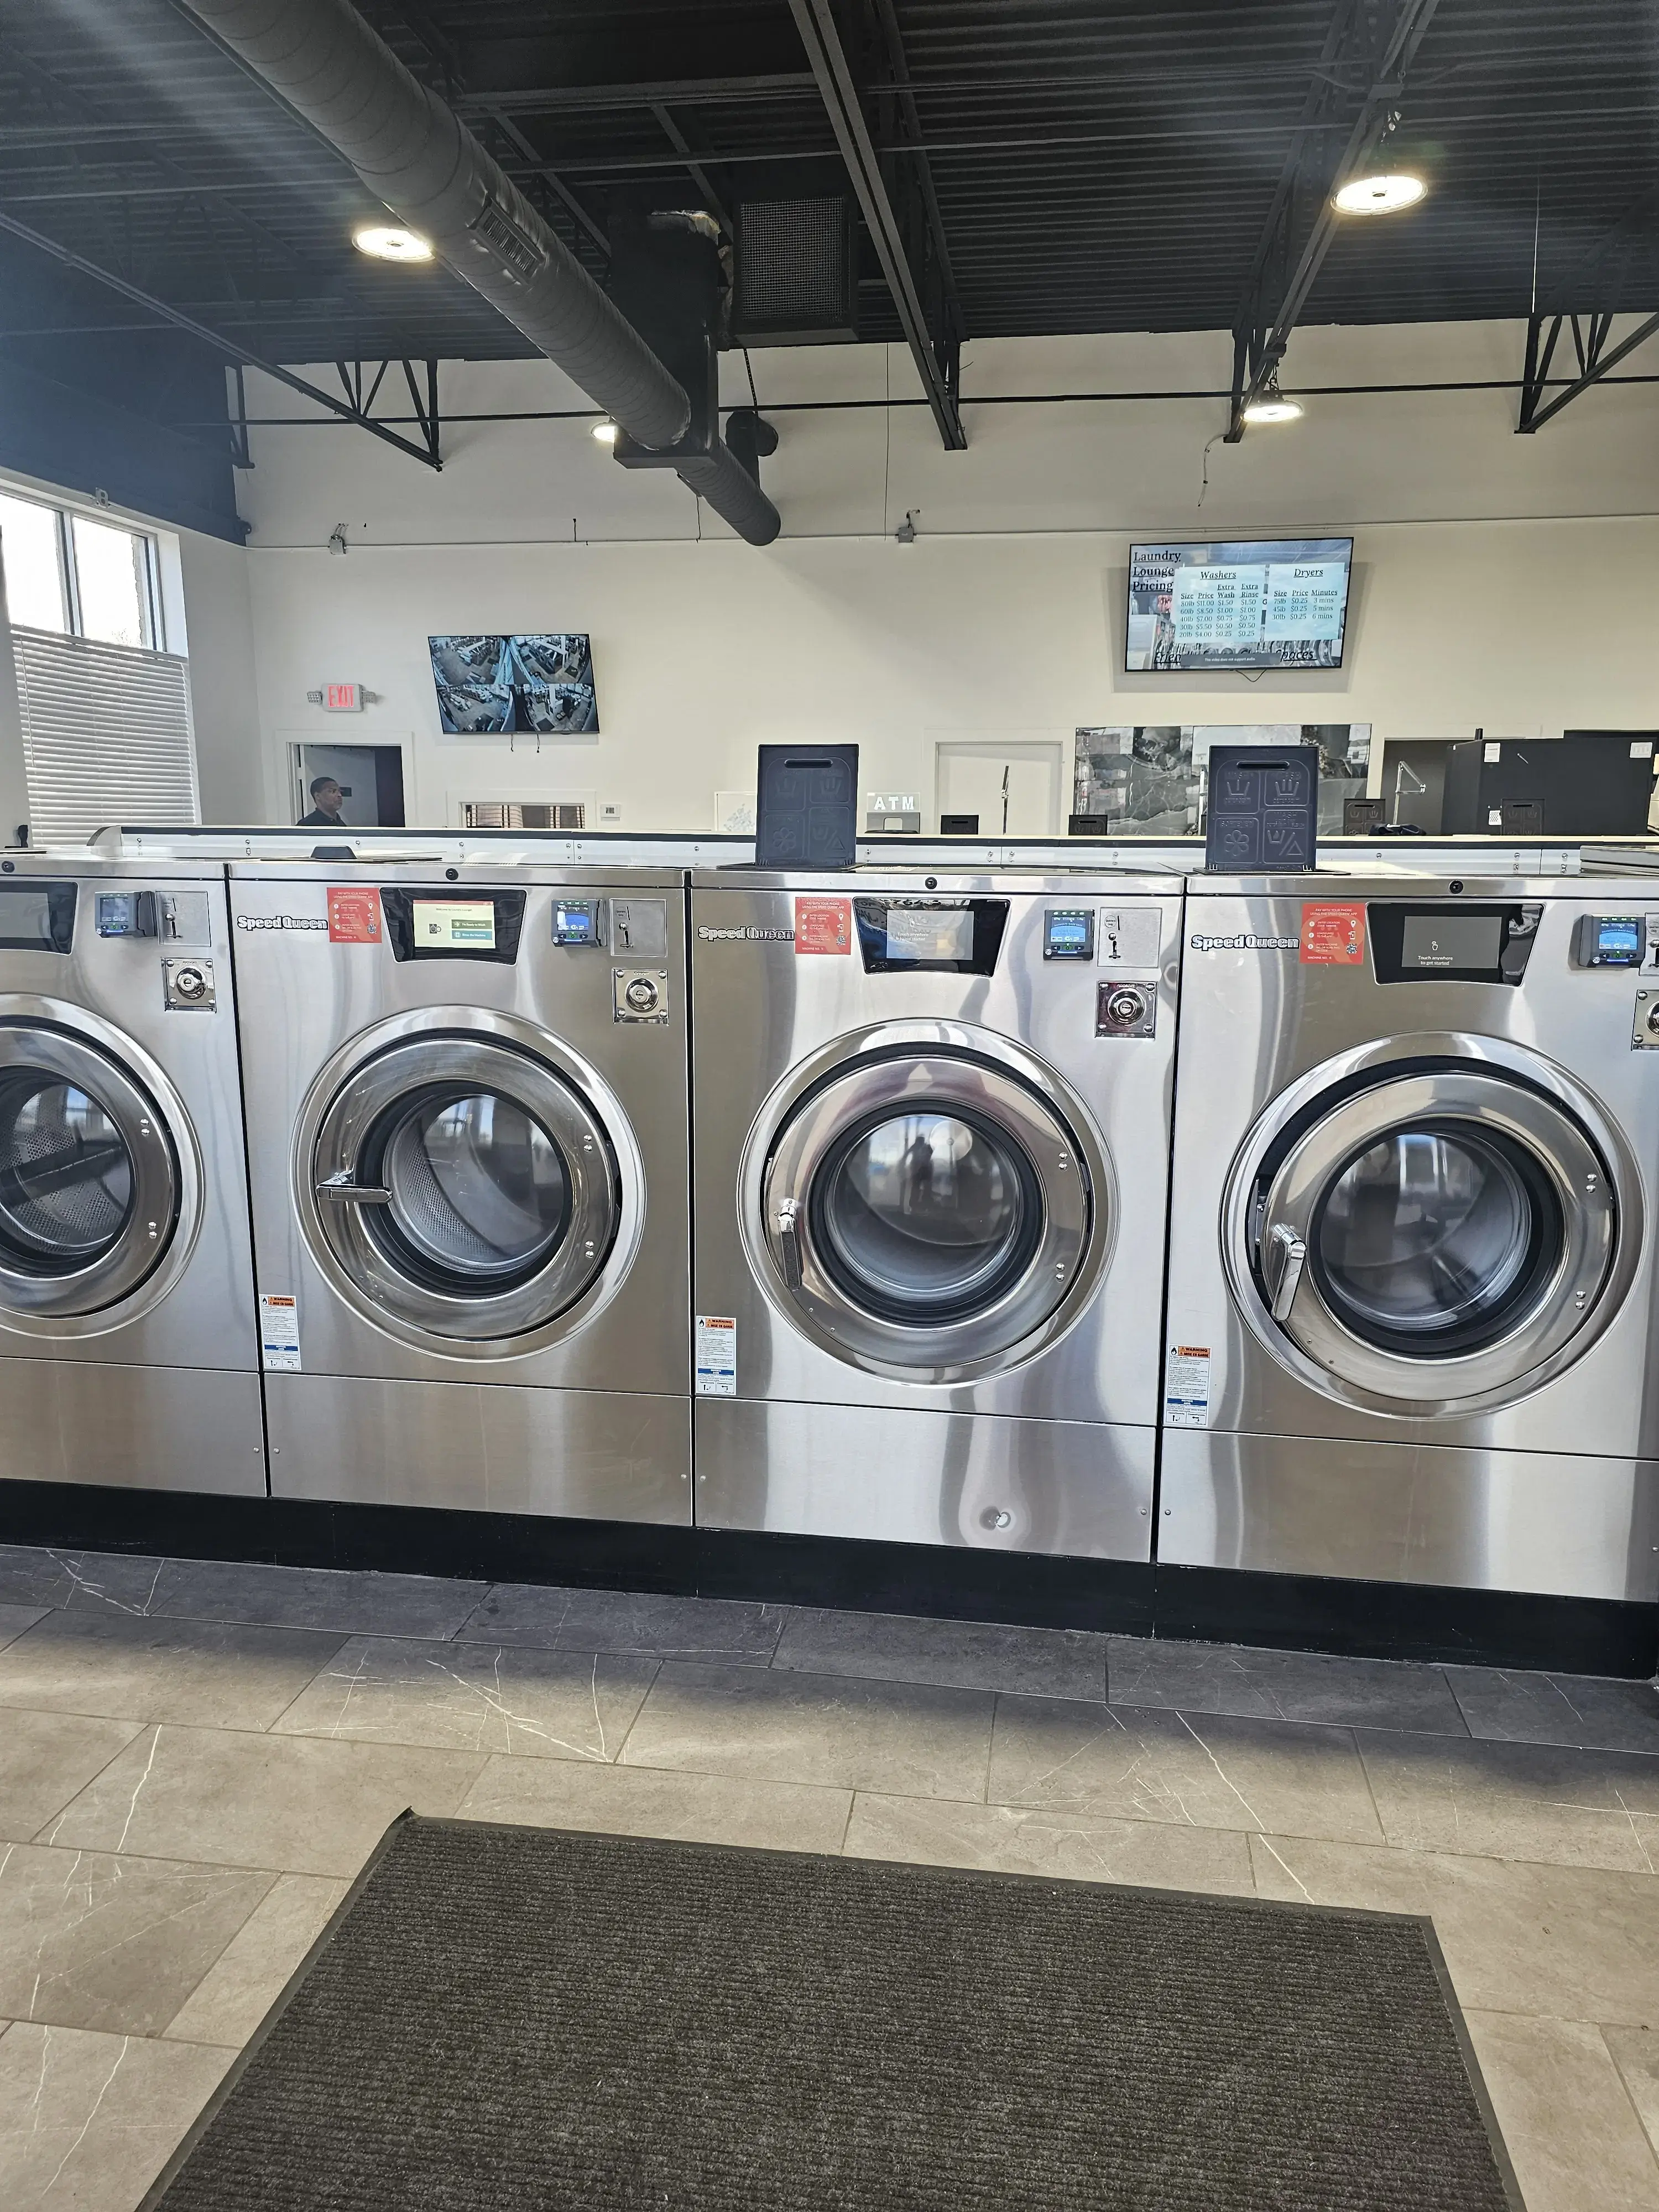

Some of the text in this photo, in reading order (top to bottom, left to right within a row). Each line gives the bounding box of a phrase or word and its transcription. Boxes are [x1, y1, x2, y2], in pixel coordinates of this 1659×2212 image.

[1134, 551, 1181, 563] Laundry
[1133, 566, 1174, 578] Lounge
[1200, 571, 1237, 580] Washers
[1293, 568, 1323, 578] Dryers
[1132, 580, 1173, 593] Pricing
[327, 685, 354, 707] EXIT
[874, 796, 914, 810] ATM
[237, 915, 281, 932] Speed
[281, 916, 328, 930] Queen
[697, 926, 746, 942] Speed
[746, 926, 795, 941] Queen
[1191, 935, 1300, 951] Speed Queen
